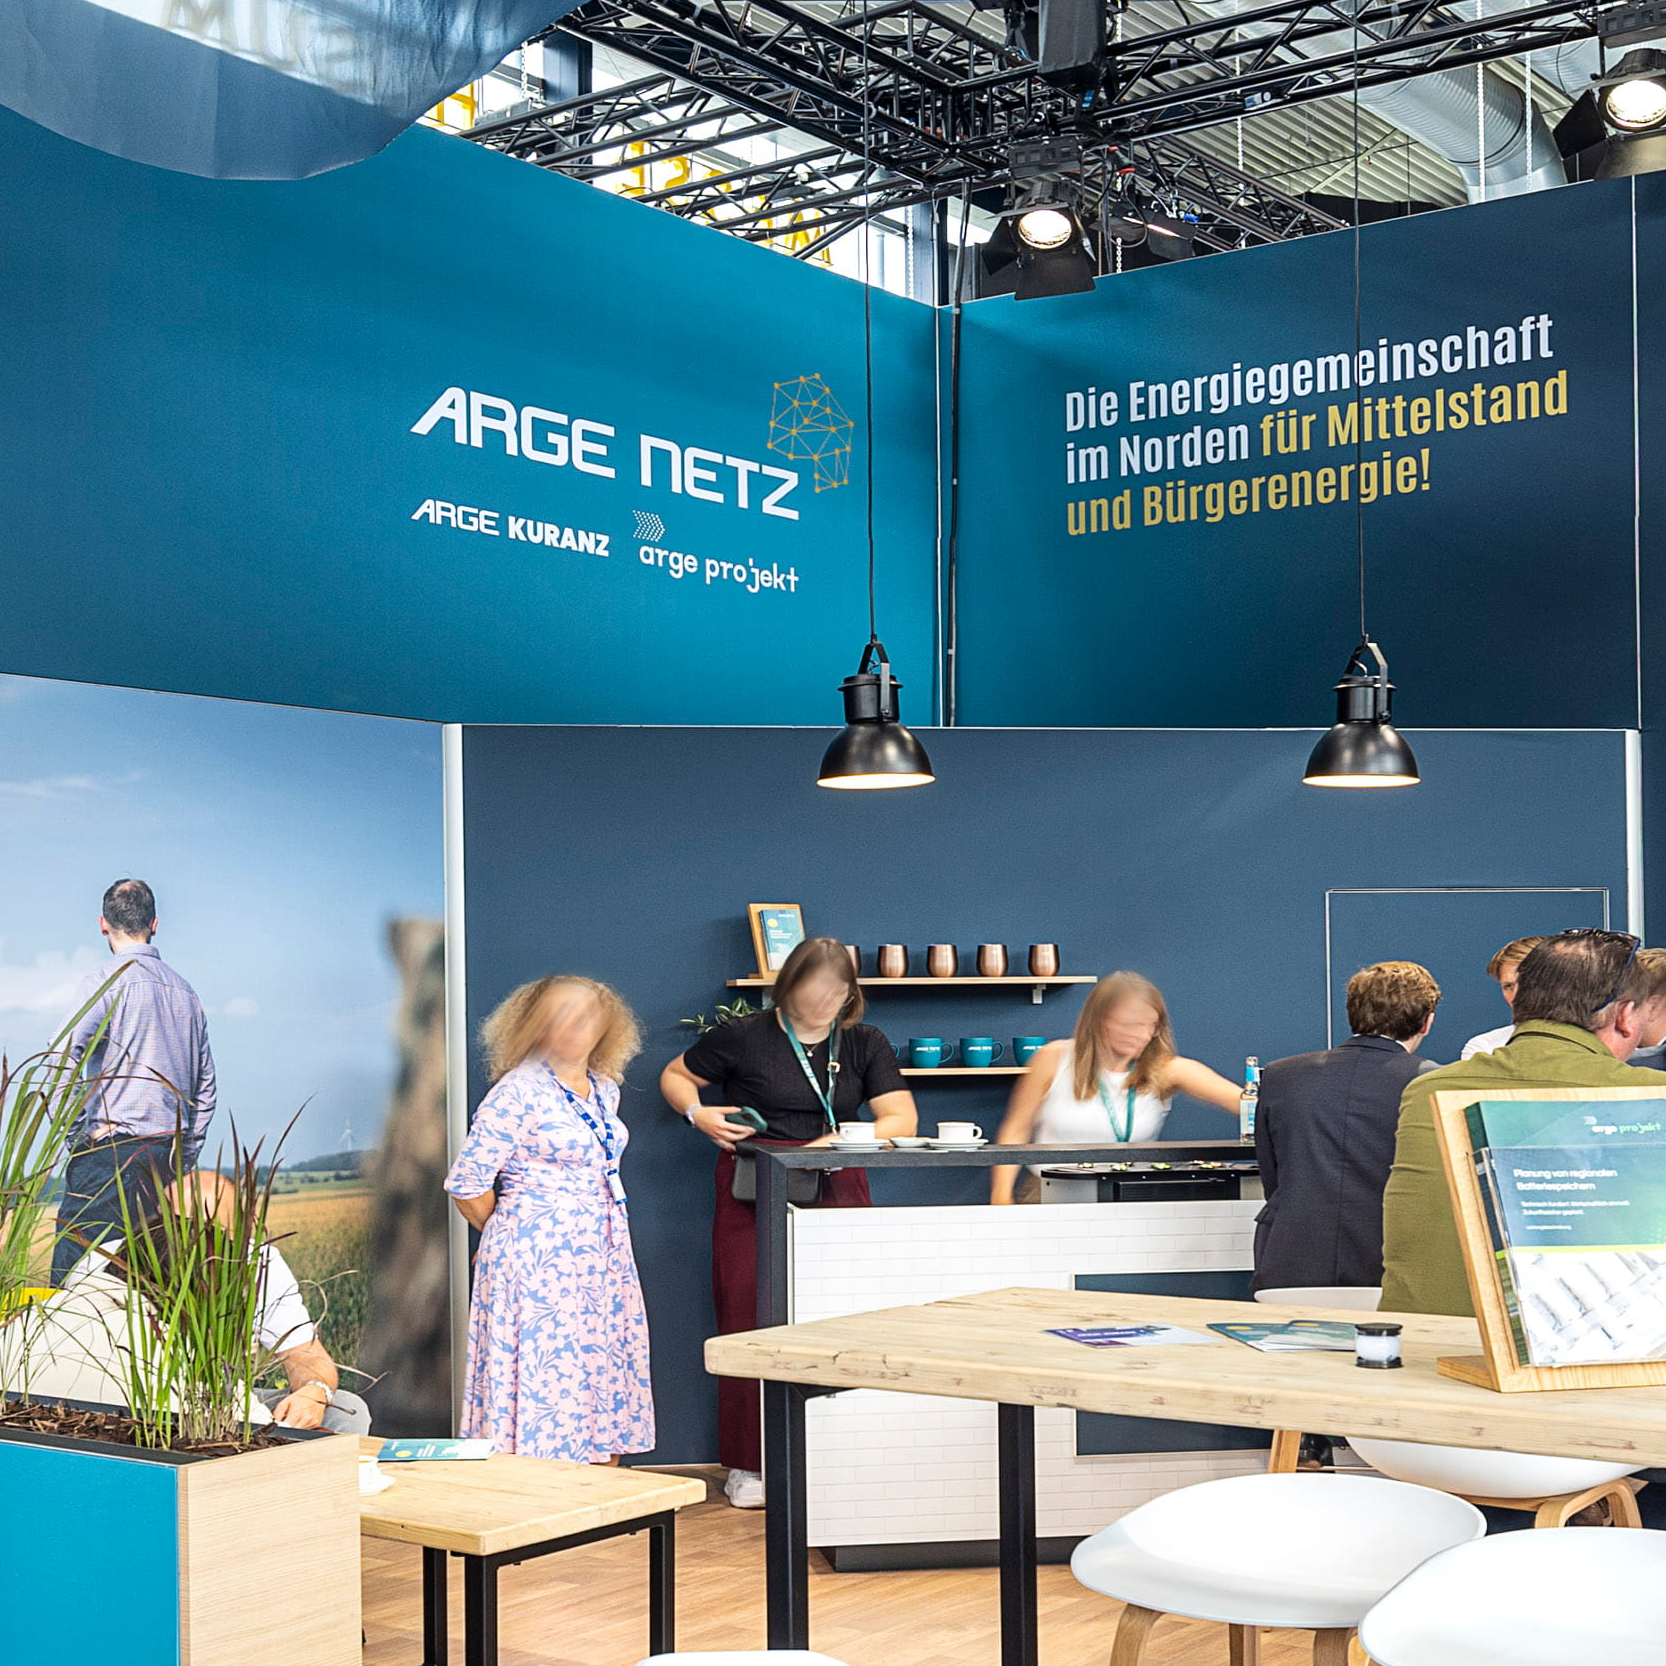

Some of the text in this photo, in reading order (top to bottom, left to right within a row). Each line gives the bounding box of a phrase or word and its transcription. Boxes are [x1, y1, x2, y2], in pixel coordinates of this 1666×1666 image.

[1065, 313, 1554, 433] Die Energiegemeinschaft
[410, 386, 800, 521] ARGE NETZ
[1066, 369, 1569, 485] im Norden für Mittelstand
[410, 498, 610, 558] ARGE KURANZ
[1066, 447, 1431, 536] und Bürgerenergie!
[638, 543, 800, 593] arge projekt
